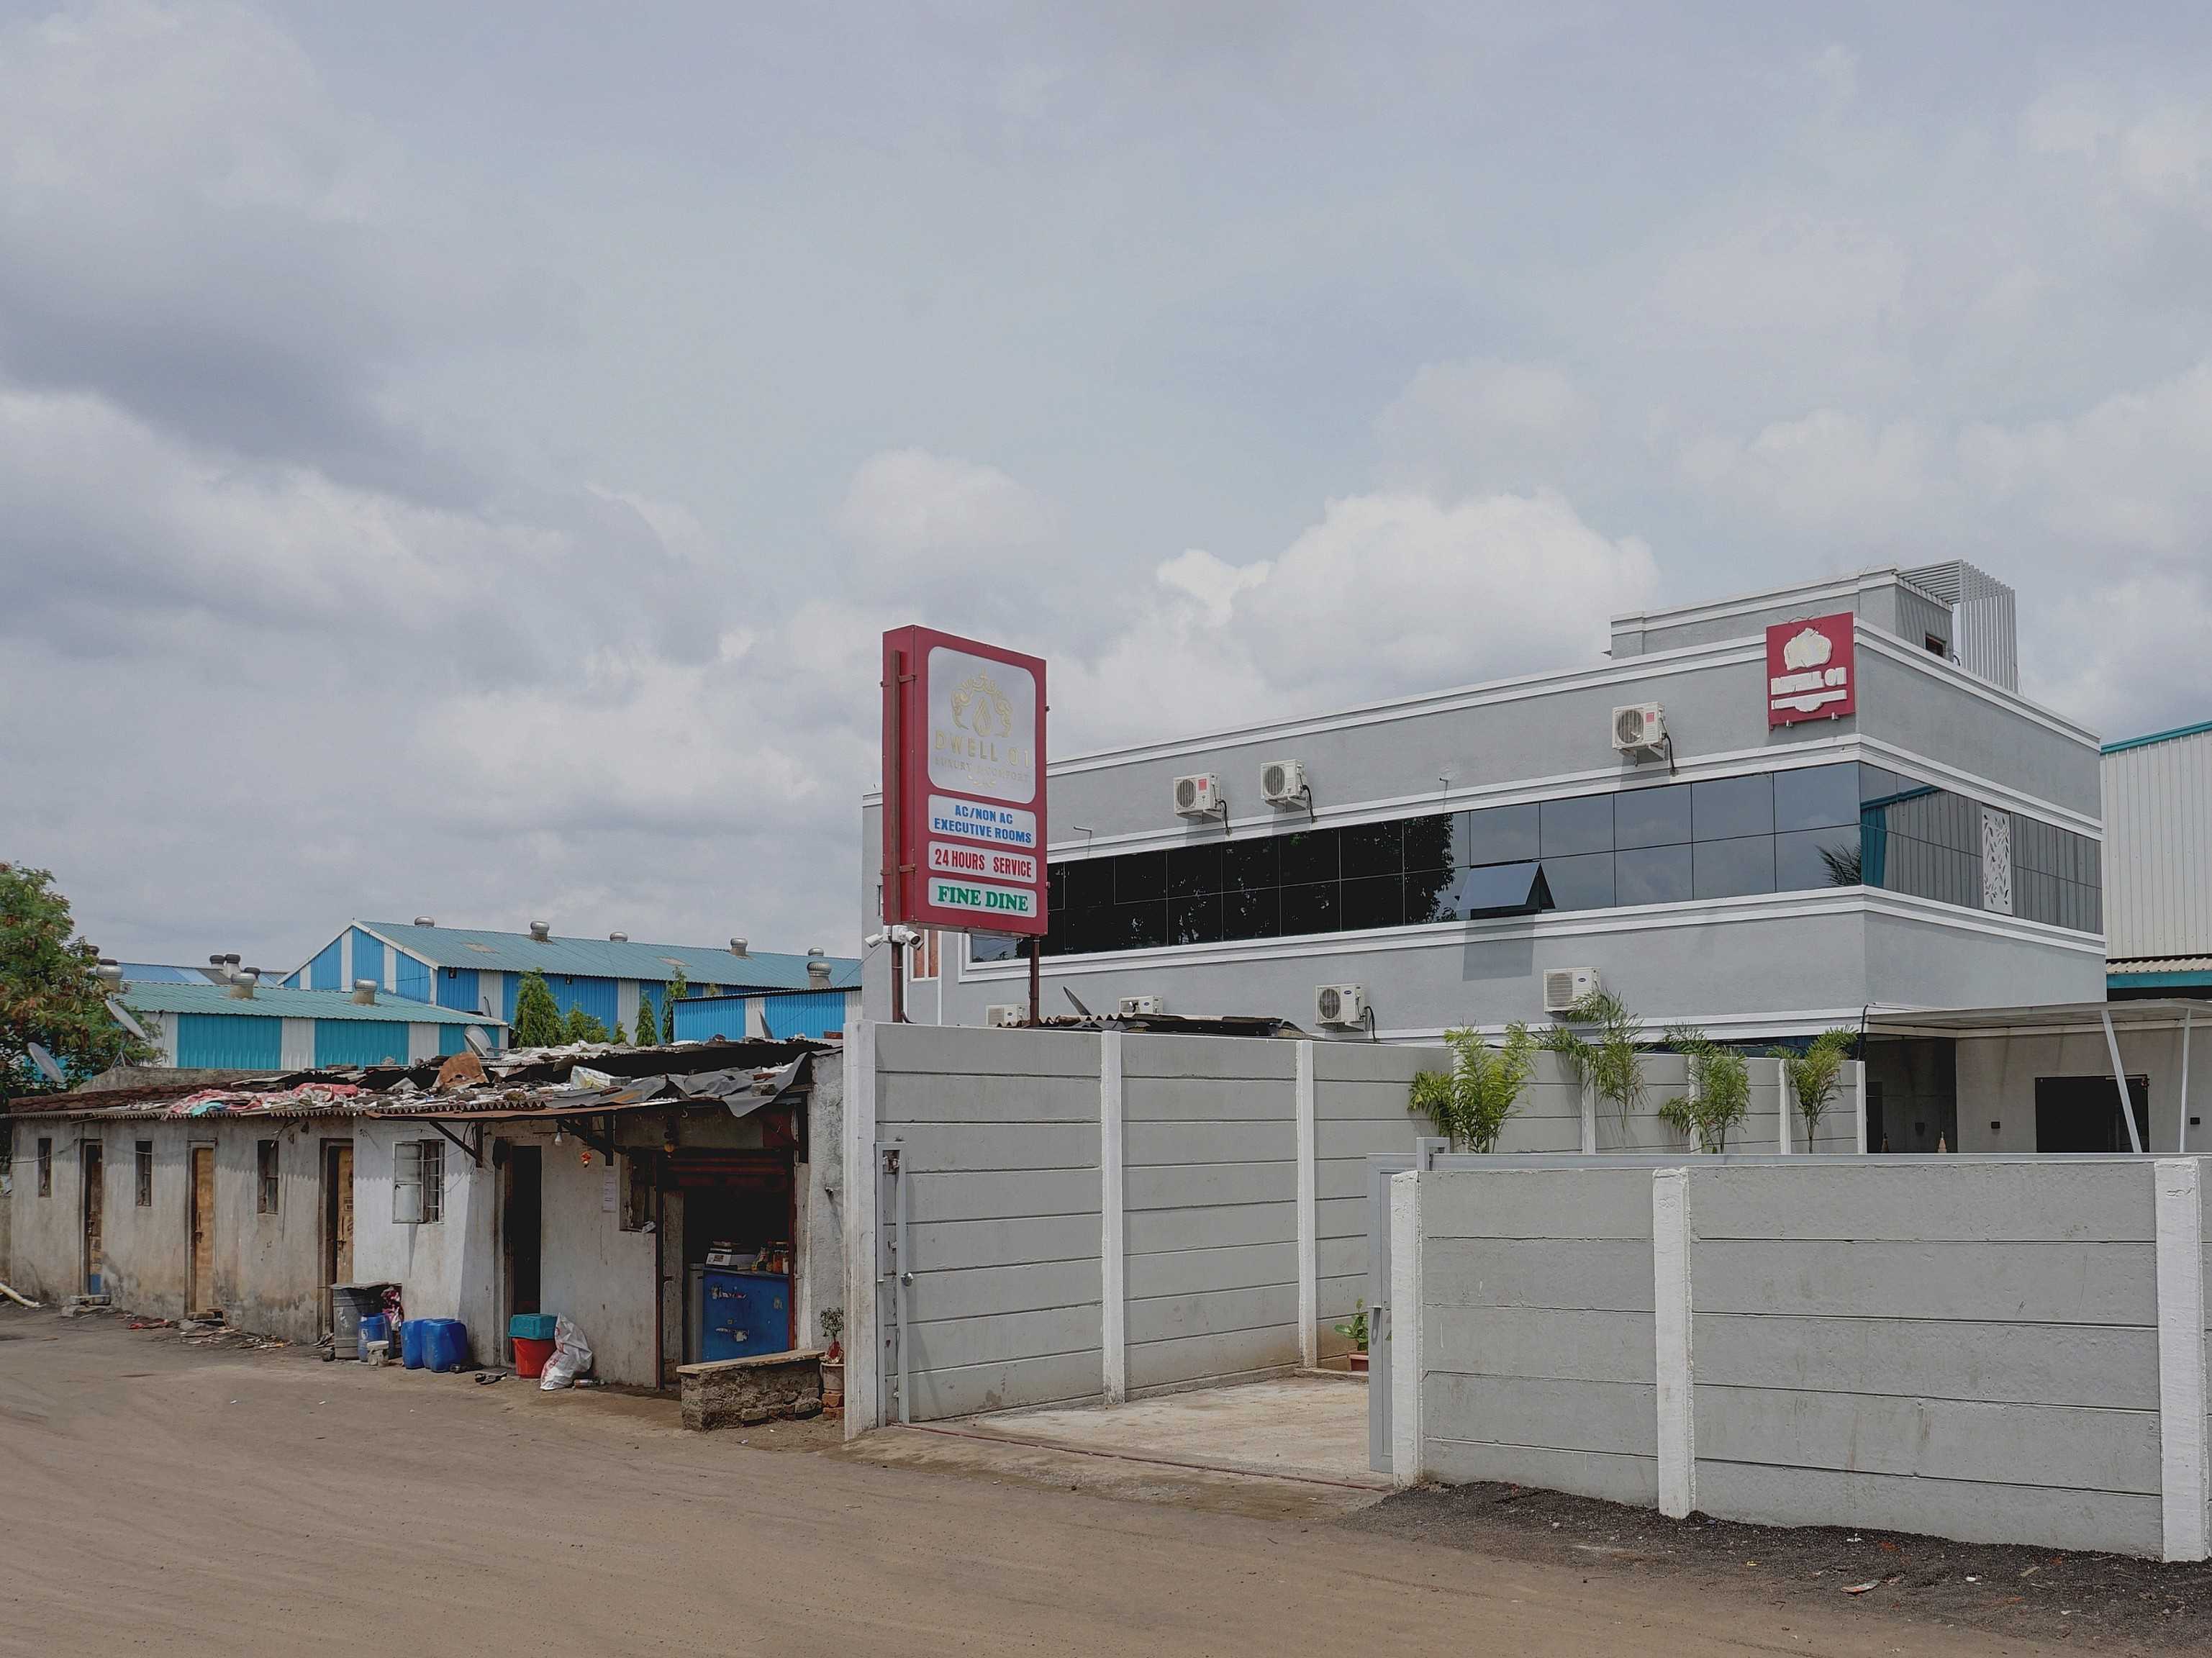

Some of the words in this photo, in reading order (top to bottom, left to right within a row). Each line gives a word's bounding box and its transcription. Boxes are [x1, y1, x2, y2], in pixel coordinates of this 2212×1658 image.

[935, 730, 997, 761] DWELL
[1008, 748, 1029, 768] 01
[955, 805, 996, 822] AC/NON
[1000, 812, 1012, 824] AC
[934, 818, 992, 837] EXECUTIVE
[994, 828, 1031, 843] ROOMS
[935, 848, 949, 866] 24
[952, 851, 985, 871] HOURS
[993, 856, 1031, 877] SERVICE
[938, 885, 982, 906] FINE
[985, 892, 1028, 911] DINE
